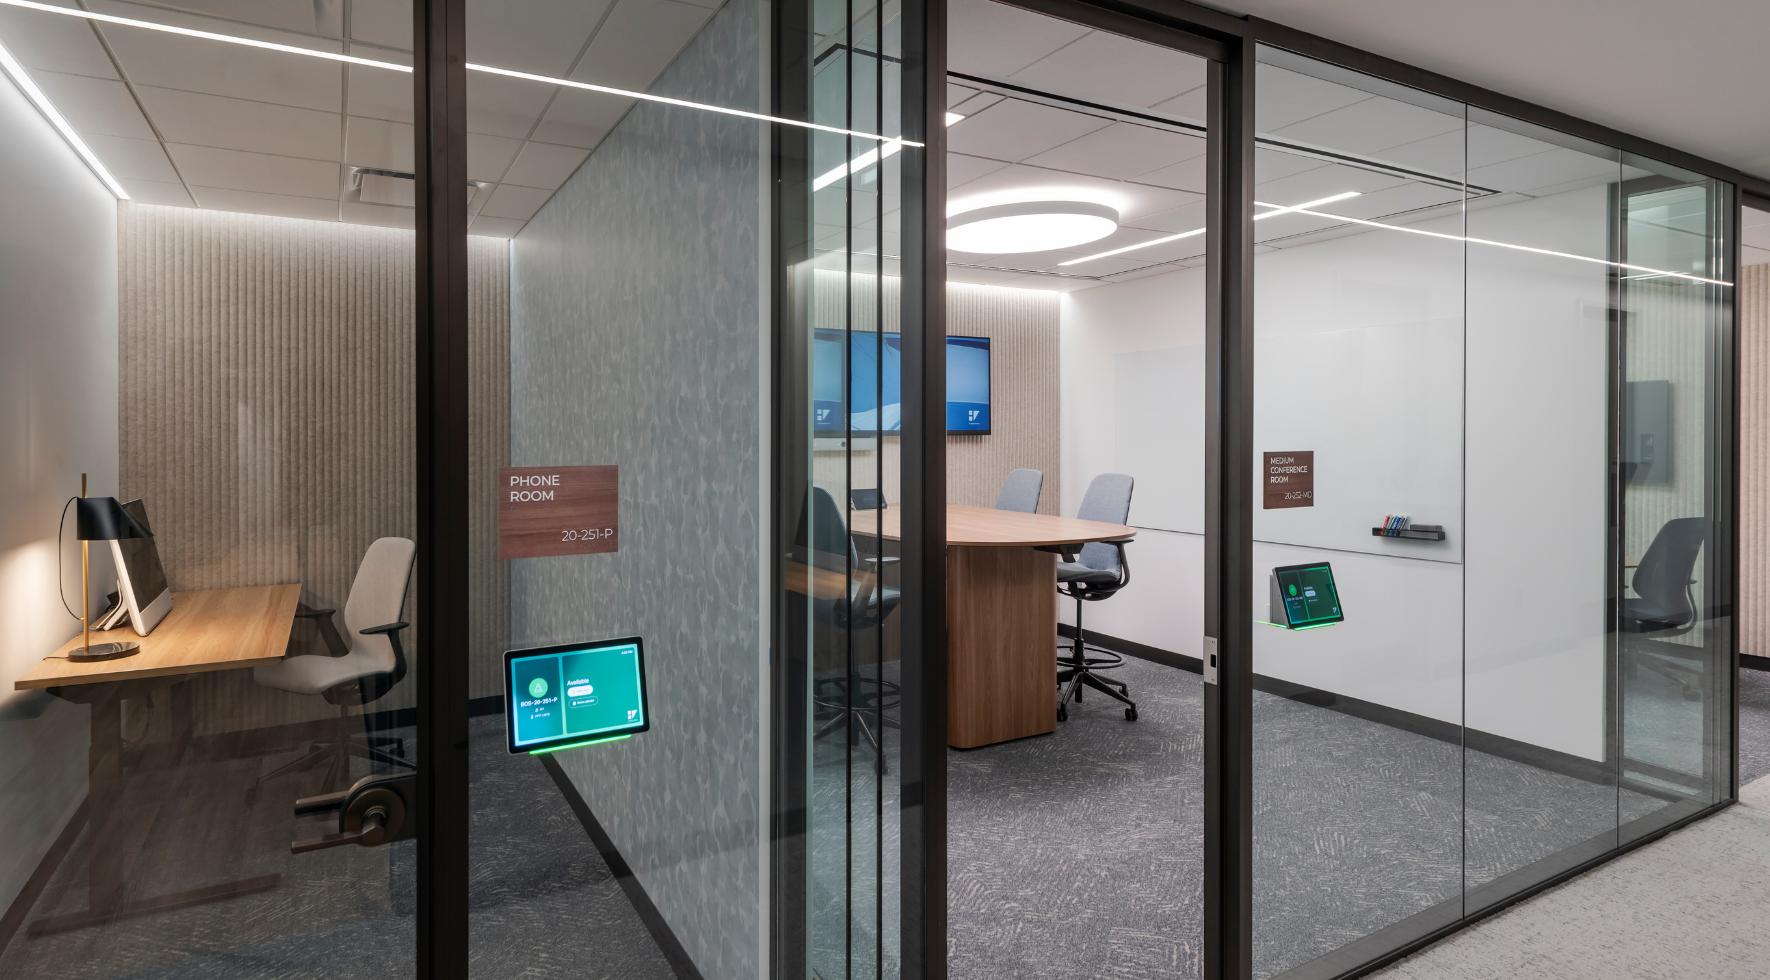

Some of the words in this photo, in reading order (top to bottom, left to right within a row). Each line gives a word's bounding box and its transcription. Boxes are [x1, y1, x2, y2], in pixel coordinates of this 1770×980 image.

[1270, 457, 1295, 465] MEDIUM
[1270, 465, 1308, 474] CONFERENCE
[510, 475, 560, 487] PHONE
[1270, 476, 1289, 484] ROOM
[510, 490, 554, 502] ROOM
[561, 528, 613, 542] 20-251-P
